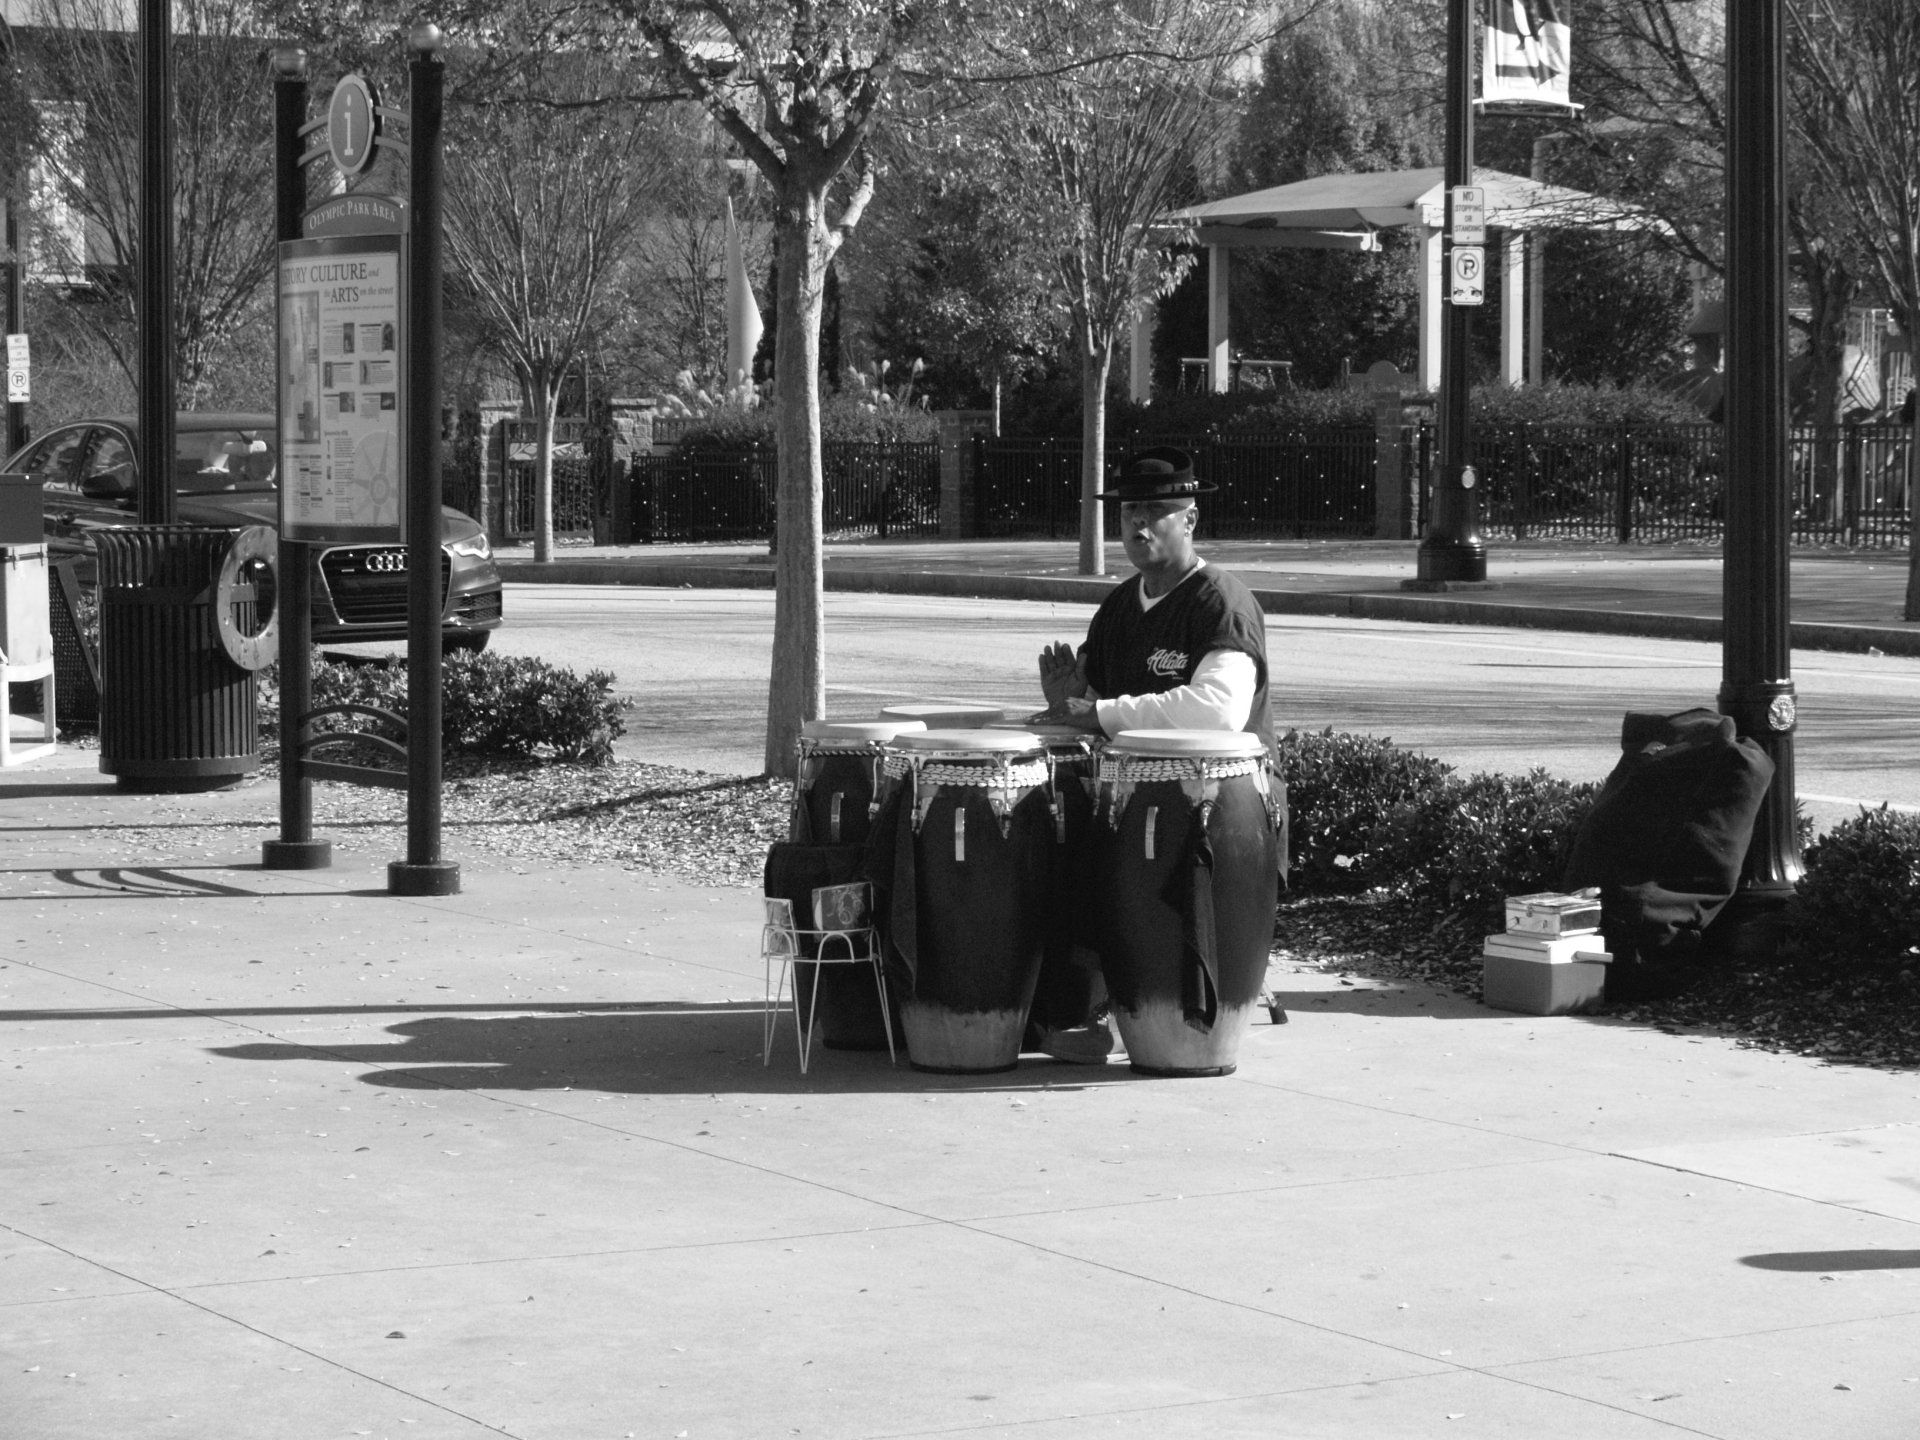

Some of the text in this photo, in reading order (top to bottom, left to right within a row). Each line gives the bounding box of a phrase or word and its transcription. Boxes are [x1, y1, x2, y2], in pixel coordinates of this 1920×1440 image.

[1462, 191, 1474, 202] NO
[1454, 204, 1482, 213] STOPPING
[309, 200, 396, 230] OLYMPIC PARK AREA
[1464, 215, 1473, 223] OR
[1454, 224, 1482, 233] STANDING
[310, 262, 368, 282] CULTURE
[330, 286, 360, 303] ARTS
